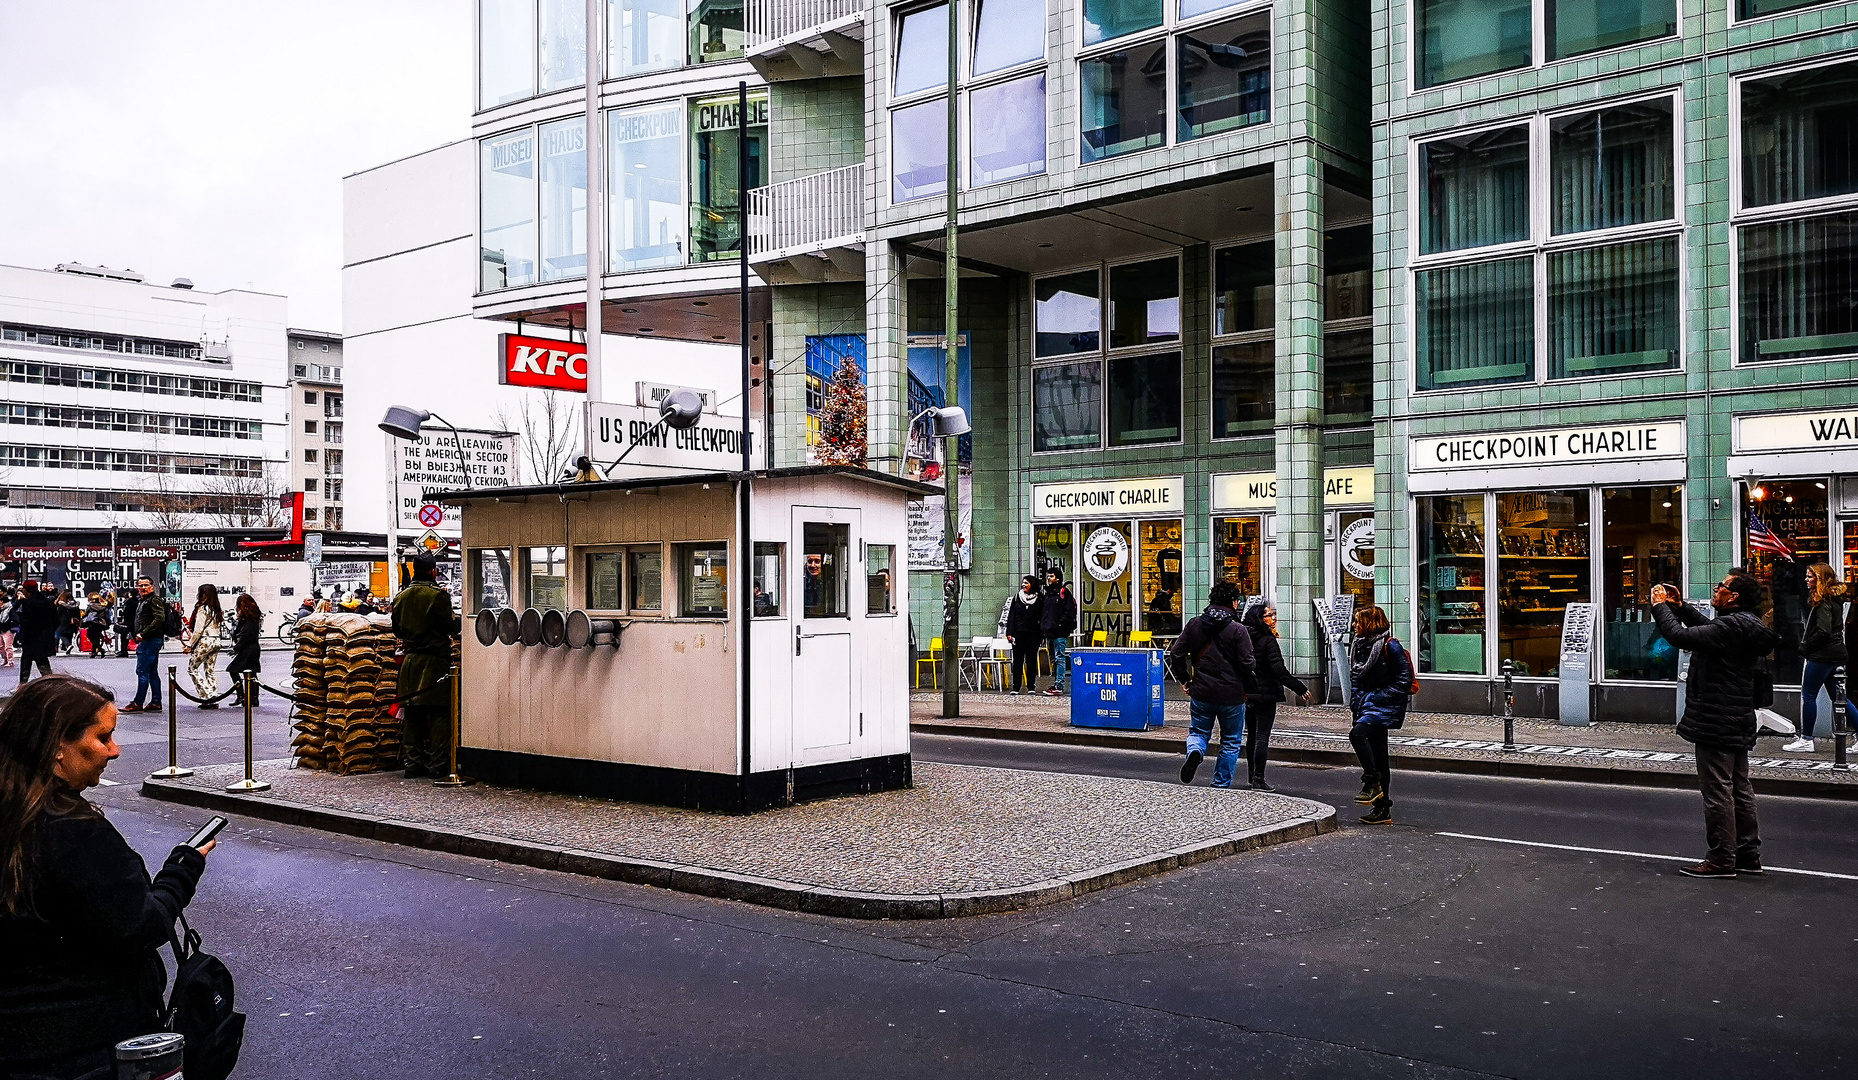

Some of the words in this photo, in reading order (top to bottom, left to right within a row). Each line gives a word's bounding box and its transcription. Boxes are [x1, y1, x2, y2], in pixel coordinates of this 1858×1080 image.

[550, 127, 583, 151] HAUS
[700, 100, 768, 130] CHARIE
[511, 345, 587, 380] KFC
[436, 437, 457, 448] ARE
[462, 438, 503, 451] LEAVING
[629, 420, 669, 448] ARMY
[676, 427, 754, 455] CHECKPOIT
[1436, 434, 1558, 464] CHECKPOINT
[1568, 428, 1658, 456] CHARLIE
[404, 446, 421, 458] THE
[476, 451, 508, 463] SECTOR
[405, 460, 422, 471] ВЫ
[493, 466, 506, 475] ИЗ
[475, 476, 509, 488] СЕКТОРА
[404, 497, 416, 508] DU
[1045, 490, 1115, 508] CHECKPOINT
[1119, 487, 1170, 505] CHARLIE
[404, 511, 412, 520] SIE
[1085, 529, 1109, 552] CHECKPOINT
[1111, 529, 1127, 552] CHARLIE
[1341, 519, 1371, 547] CHECKPOINT
[13, 548, 74, 560] Checkpoint
[77, 548, 113, 558] Charlie
[120, 547, 169, 558] BlackBox
[75, 571, 118, 581] CURTAI
[1089, 565, 1123, 580] MUSEUMSCAFE
[1085, 672, 1102, 685] LIFE
[1105, 673, 1114, 685] IN
[1116, 673, 1133, 686] THE
[1100, 689, 1117, 702] GDR
